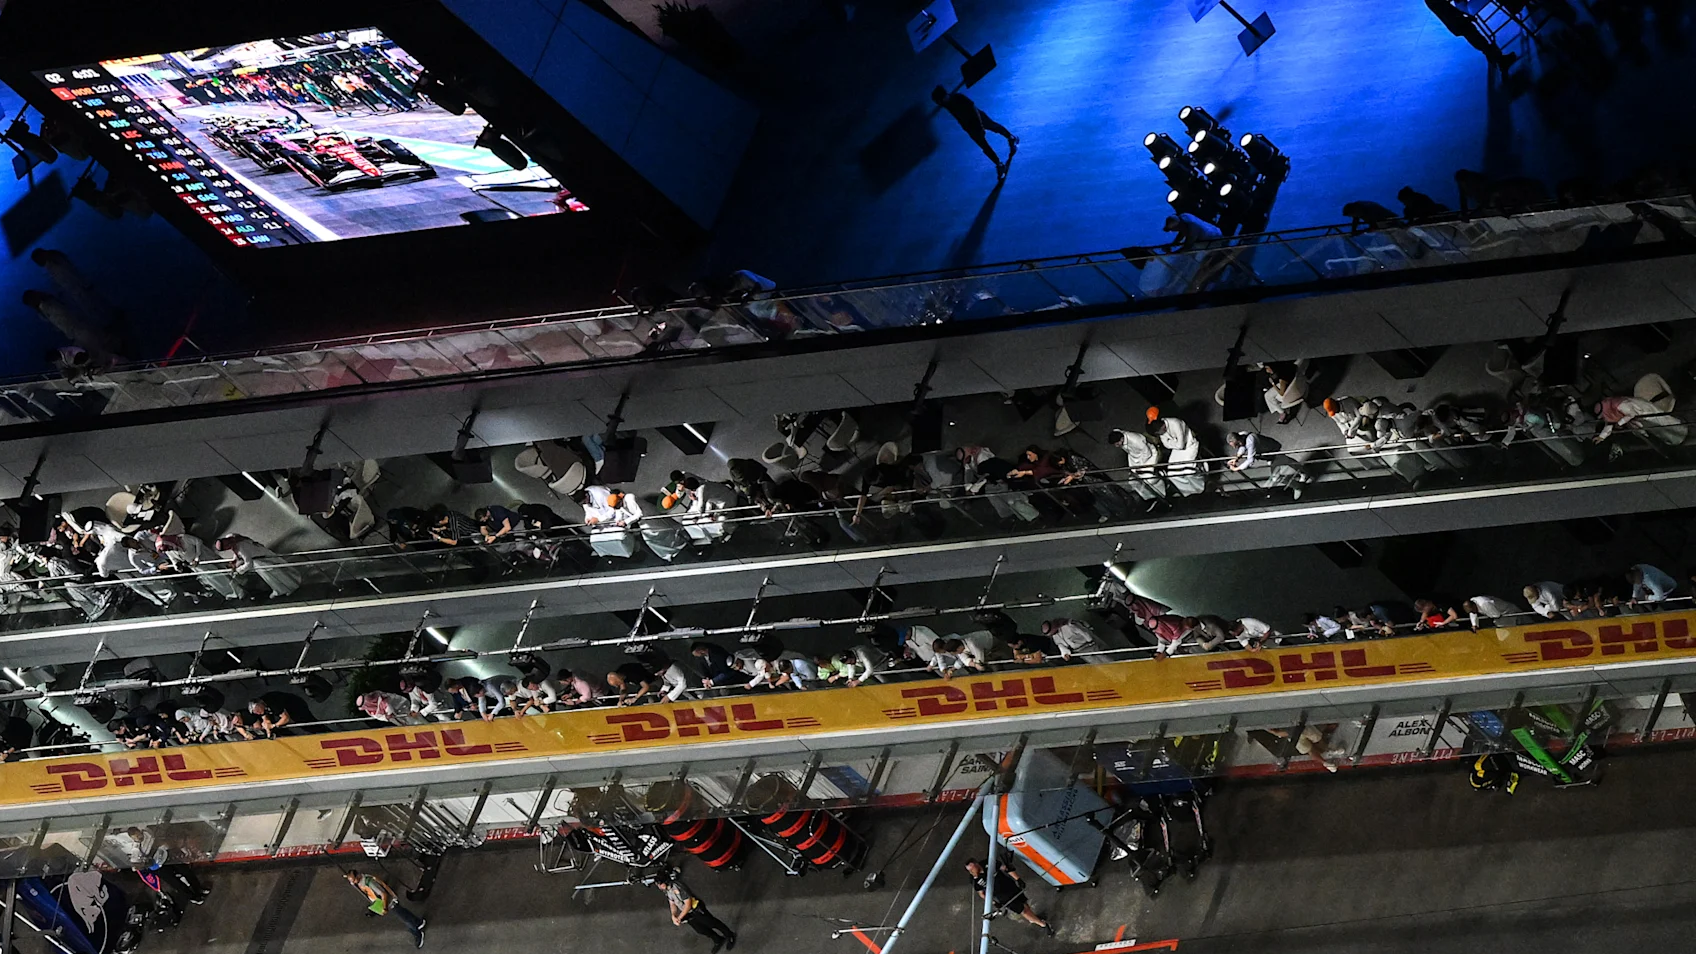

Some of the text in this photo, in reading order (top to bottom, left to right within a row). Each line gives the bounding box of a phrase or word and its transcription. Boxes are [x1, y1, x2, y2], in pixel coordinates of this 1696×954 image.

[45, 69, 100, 84] Q2 4:01
[71, 87, 95, 96] NOR
[83, 98, 105, 107] VER
[96, 109, 116, 118] PIA
[125, 105, 144, 114] +0.2
[108, 119, 130, 128] RUS
[121, 130, 142, 138] LEC
[135, 141, 155, 149] ALB
[146, 151, 168, 159] TSU
[159, 162, 185, 171] HAM
[172, 173, 190, 181] SAI
[185, 182, 206, 191] ANT
[183, 196, 197, 204] 11
[197, 193, 219, 202] GAS
[196, 206, 210, 214] 12
[209, 204, 232, 213] BEA
[221, 214, 245, 223] HAD
[235, 225, 255, 234] ALO
[246, 235, 270, 244] LAW
[1524, 619, 1696, 661] DHL
[1209, 649, 1395, 688] DHL
[902, 676, 1085, 716] DHL
[606, 703, 785, 742] DHL
[1396, 719, 1427, 729] ALEX
[1389, 727, 1431, 737] ALBON
[320, 729, 492, 766] DHL
[46, 754, 212, 791] DHL
